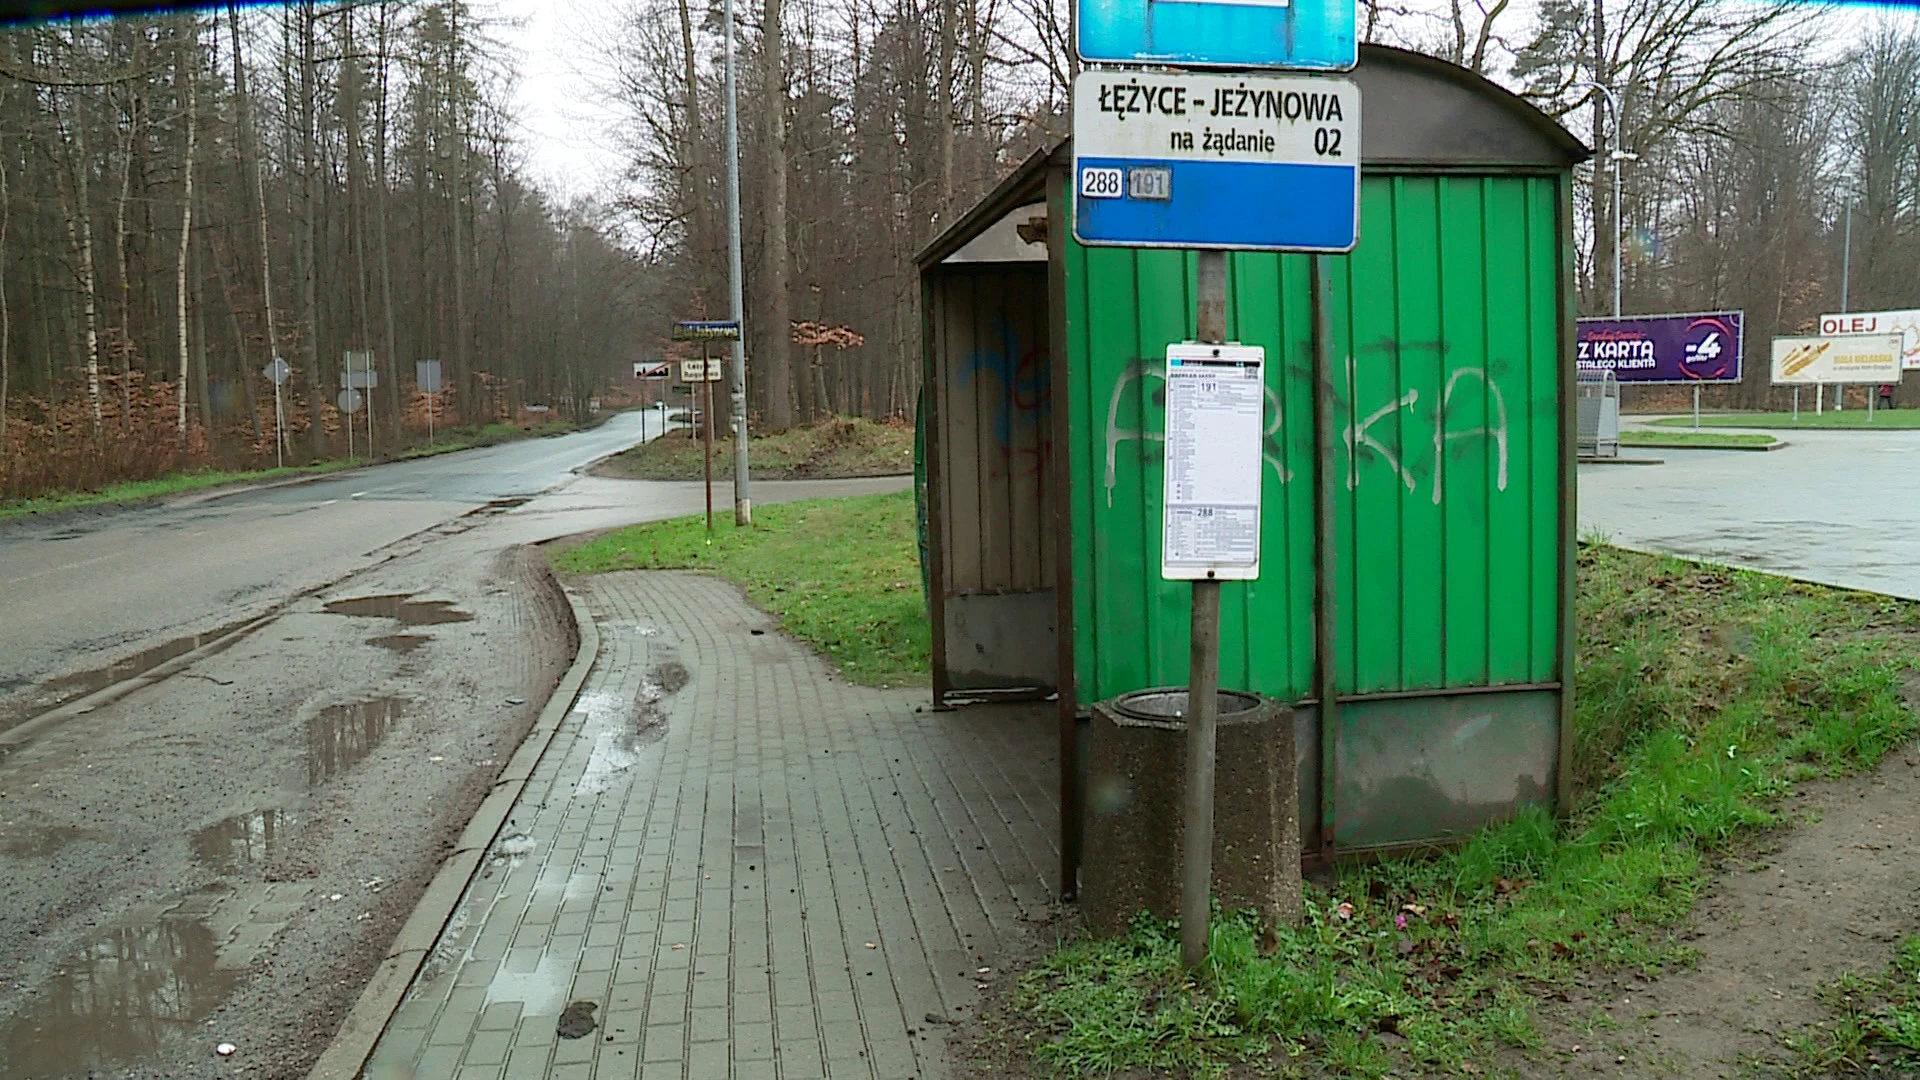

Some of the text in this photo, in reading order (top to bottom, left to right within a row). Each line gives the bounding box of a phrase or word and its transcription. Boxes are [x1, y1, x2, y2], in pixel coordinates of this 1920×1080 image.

[1098, 78, 1187, 121] ŁĘŻYCE
[1210, 83, 1344, 122] JEŻYNOWA
[1170, 126, 1276, 156] na żądanie
[1313, 127, 1342, 157] 02
[1085, 171, 1119, 194] 288
[1132, 174, 1165, 195] 191
[1823, 317, 1877, 334] OLEJ
[1577, 342, 1590, 359] Z
[1685, 332, 1722, 359] -4
[1618, 358, 1656, 370] KLIENTA
[1201, 383, 1216, 392] 191
[1198, 508, 1213, 517] 288
